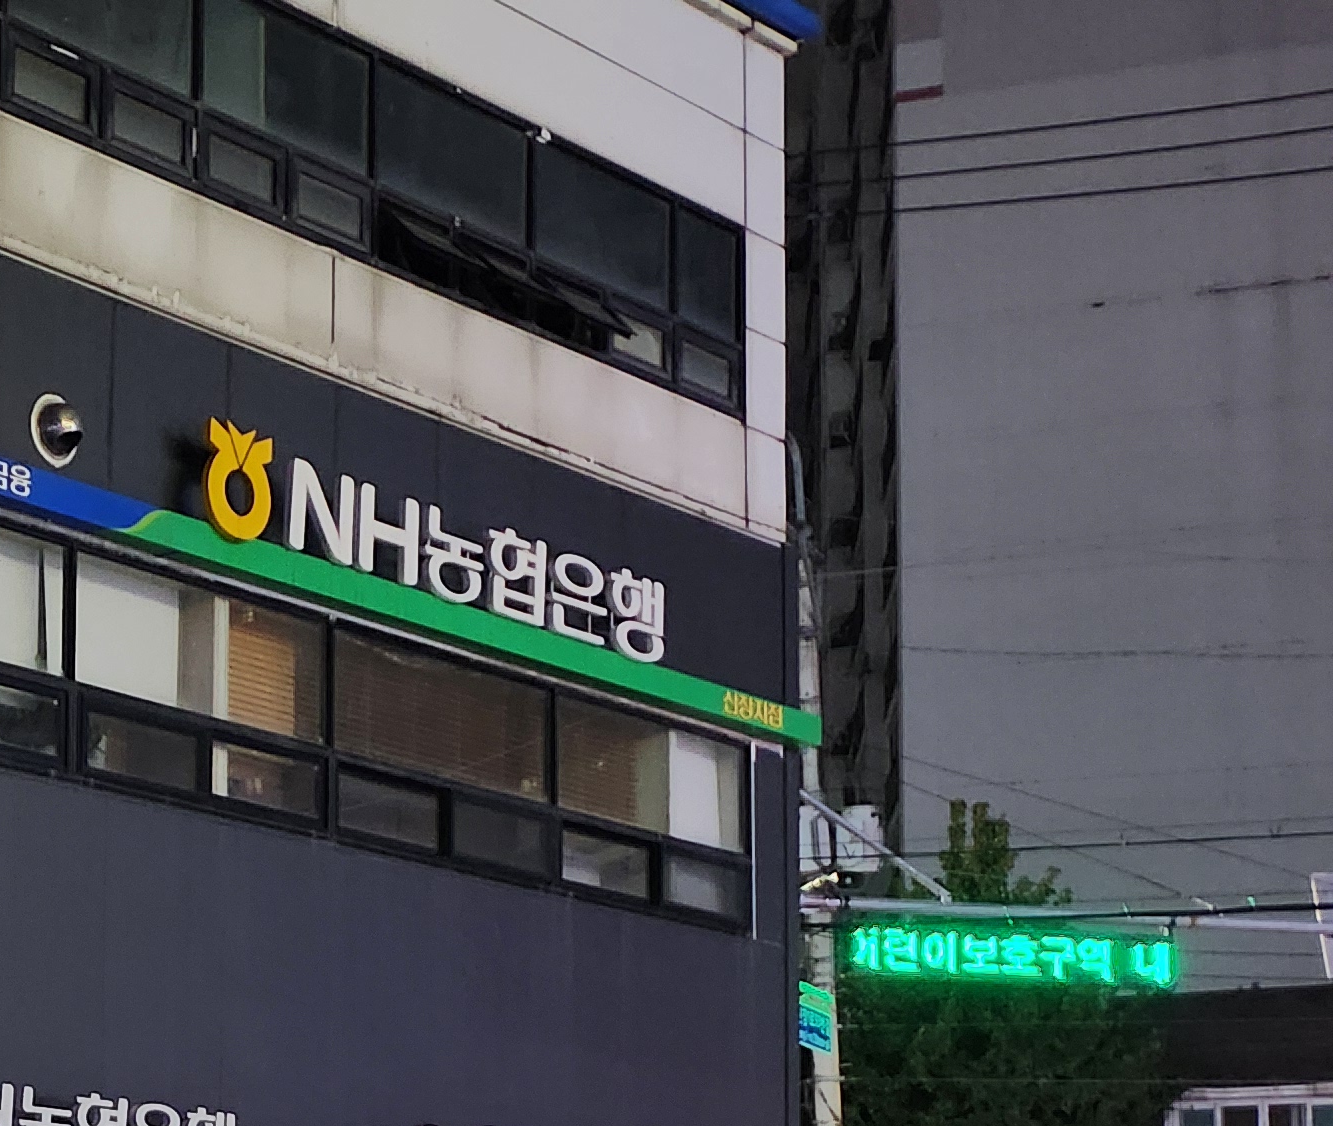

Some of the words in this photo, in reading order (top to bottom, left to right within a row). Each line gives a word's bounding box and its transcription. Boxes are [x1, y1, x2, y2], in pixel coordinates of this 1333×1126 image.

[286, 455, 668, 666] NH농협은행
[723, 689, 784, 730] 신장지점
[1133, 938, 1178, 989] 내
